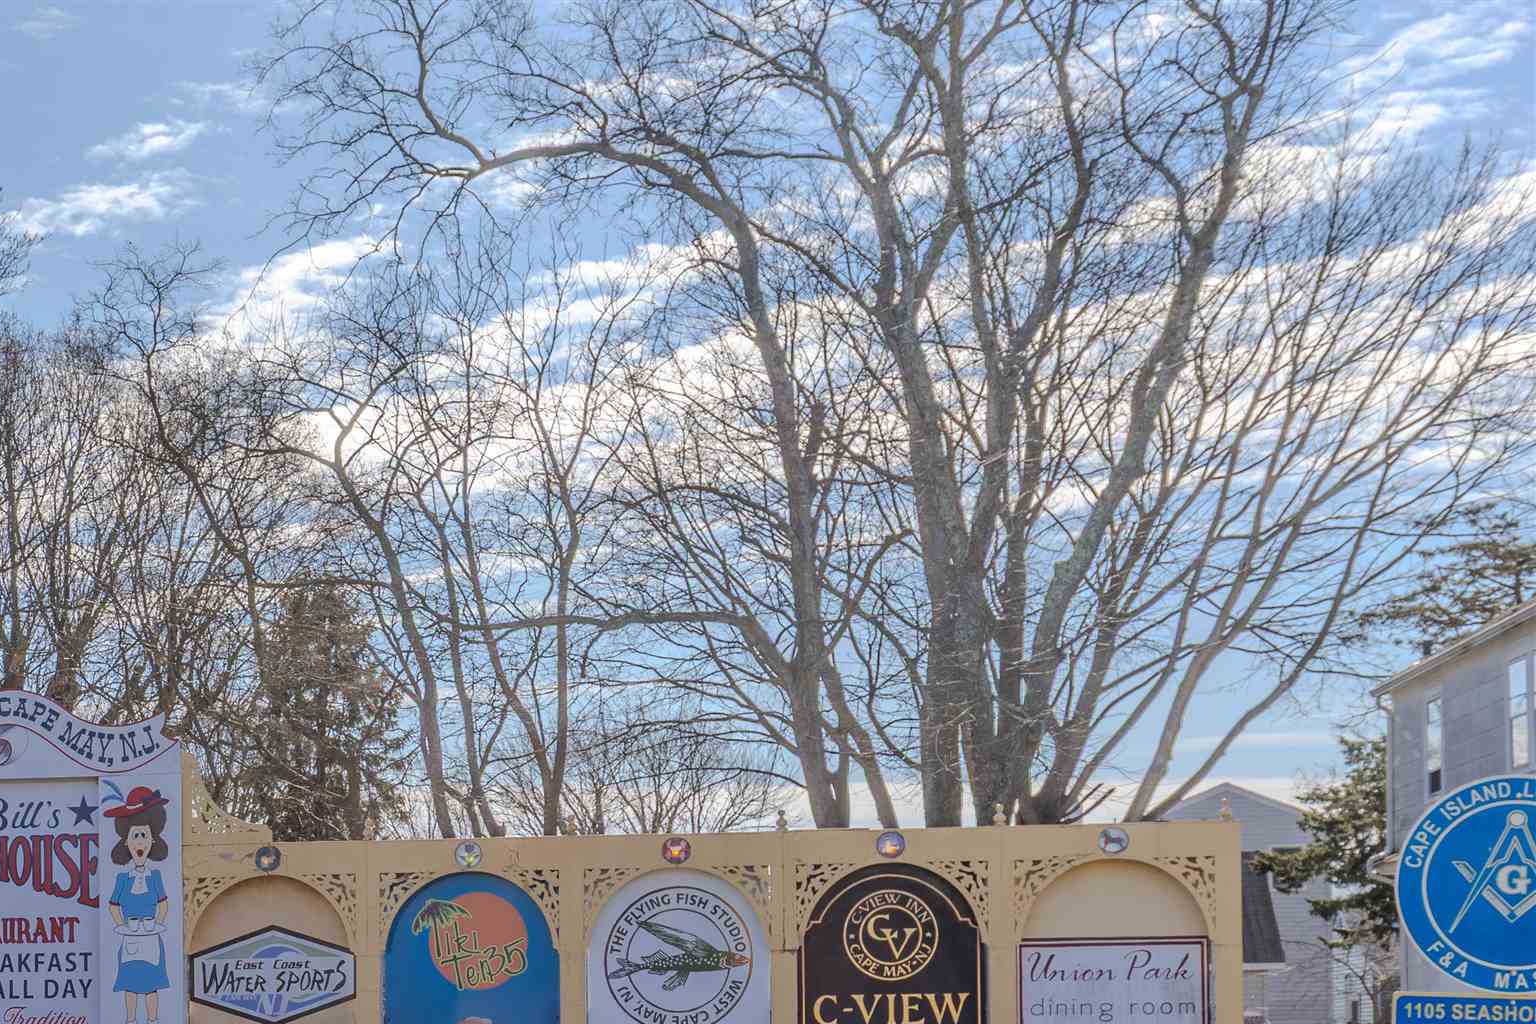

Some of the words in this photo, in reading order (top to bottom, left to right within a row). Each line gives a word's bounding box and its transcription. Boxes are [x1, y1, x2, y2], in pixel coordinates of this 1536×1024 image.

[59, 722, 116, 767] MAY,
[120, 725, 161, 763] N.J.
[1405, 819, 1441, 869] CAPE
[1439, 781, 1511, 820] ISLAND
[1496, 865, 1532, 894] G
[610, 926, 628, 955] THE
[624, 894, 671, 926] FLYING
[676, 893, 709, 909] FISH
[710, 905, 746, 953] STUDIO
[905, 898, 931, 923] INN
[234, 960, 264, 970] East
[273, 959, 312, 970] Coast
[850, 944, 879, 973] CAPE
[1028, 951, 1118, 982] Union
[1122, 949, 1196, 982] Park
[44, 979, 93, 999] DAY
[617, 985, 634, 1003] NJ
[714, 978, 743, 1015] WEST
[633, 1000, 667, 1024] MAY,
[1030, 998, 1113, 1023] dining
[1128, 1000, 1196, 1016] room
[1404, 1003, 1446, 1019] 1105
[1451, 1004, 1536, 1022] SEASHO
